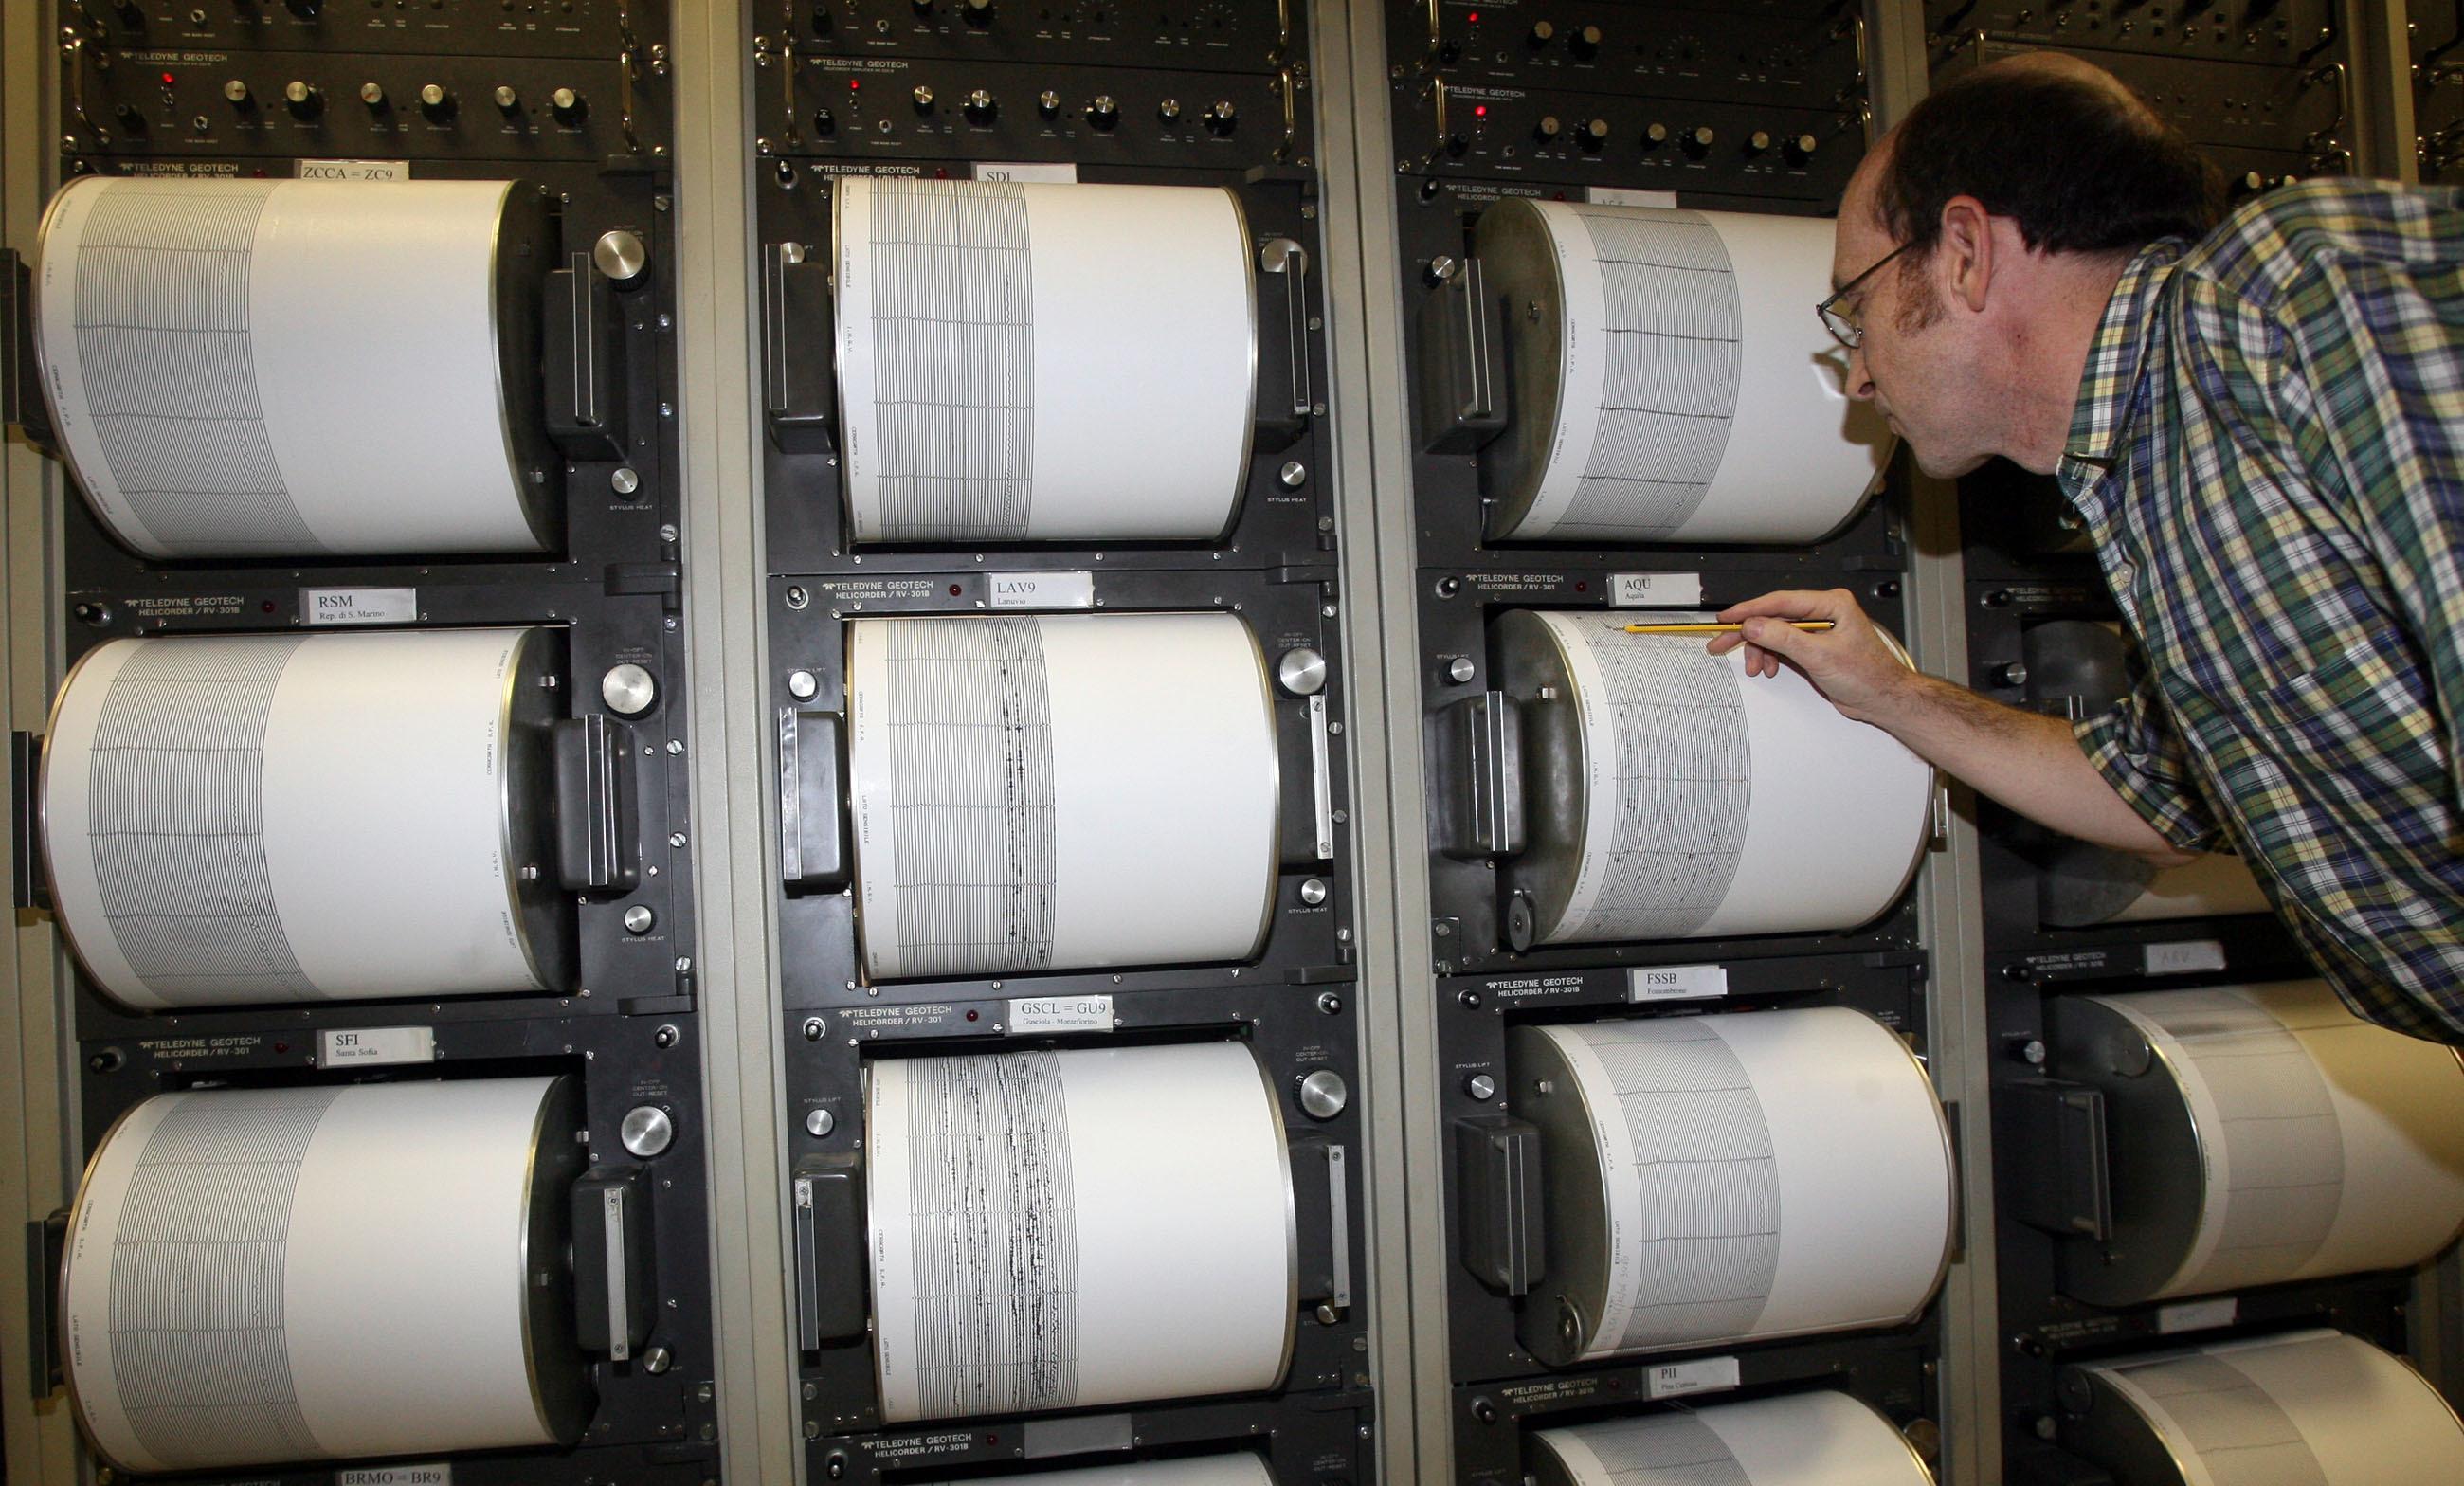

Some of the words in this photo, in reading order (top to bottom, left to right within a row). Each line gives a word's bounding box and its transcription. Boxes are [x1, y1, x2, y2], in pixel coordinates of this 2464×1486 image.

[183, 53, 227, 62] GEOTECH
[823, 59, 863, 67] TELEDYNE
[867, 60, 908, 68] GEOTECH
[1450, 86, 1486, 95] TELEDYNE
[1489, 89, 1525, 98] GEOTECH
[134, 163, 184, 172] TELEDYNE
[190, 163, 239, 172] GEOTECH
[824, 165, 872, 173] TELEDYNE
[875, 166, 920, 174] GEOTECH
[303, 167, 346, 179] ZCCA
[364, 170, 393, 180] ZC9
[1458, 185, 1497, 193] TELEDYNE
[1501, 188, 1541, 196] GEOTECH
[1523, 574, 1564, 583] GEOTECH
[836, 582, 883, 590] TELEDYNE
[887, 580, 933, 589] GEOTECH
[997, 582, 1036, 593] LAV9
[1624, 578, 1651, 591] AQU
[138, 598, 190, 607] TELEDYNE
[194, 597, 245, 606] GEOTECH
[318, 595, 353, 608] RSM
[319, 612, 335, 621] Rep.
[1497, 979, 1540, 988] TELEDYNE
[1543, 977, 1584, 987] GEOTECH
[1647, 972, 1677, 984] FSSB
[1497, 988, 1543, 997] HELICORDER
[852, 1008, 900, 1018] TELEDYNE
[905, 1006, 951, 1016] GEOTECH
[1021, 1002, 1060, 1014] GSCL
[1077, 1002, 1106, 1014] GU9
[853, 1018, 903, 1026] HELICORDER
[154, 1039, 206, 1049] TELEDYNE
[210, 1037, 261, 1046] GEOTECH
[335, 1034, 358, 1046] SFI
[154, 1049, 208, 1059] HELICORDER
[358, 1047, 378, 1056] Sofia
[1513, 1383, 1555, 1395] TELEDYNE
[1558, 1378, 1598, 1389] GEOTECH
[1513, 1392, 1558, 1404] HELICORDER
[875, 1437, 922, 1449] TELEDYNE
[926, 1433, 972, 1444] GEOTECH
[875, 1447, 925, 1458] HELICORDER
[345, 1472, 393, 1484] BRMO
[411, 1471, 441, 1484] BR9
